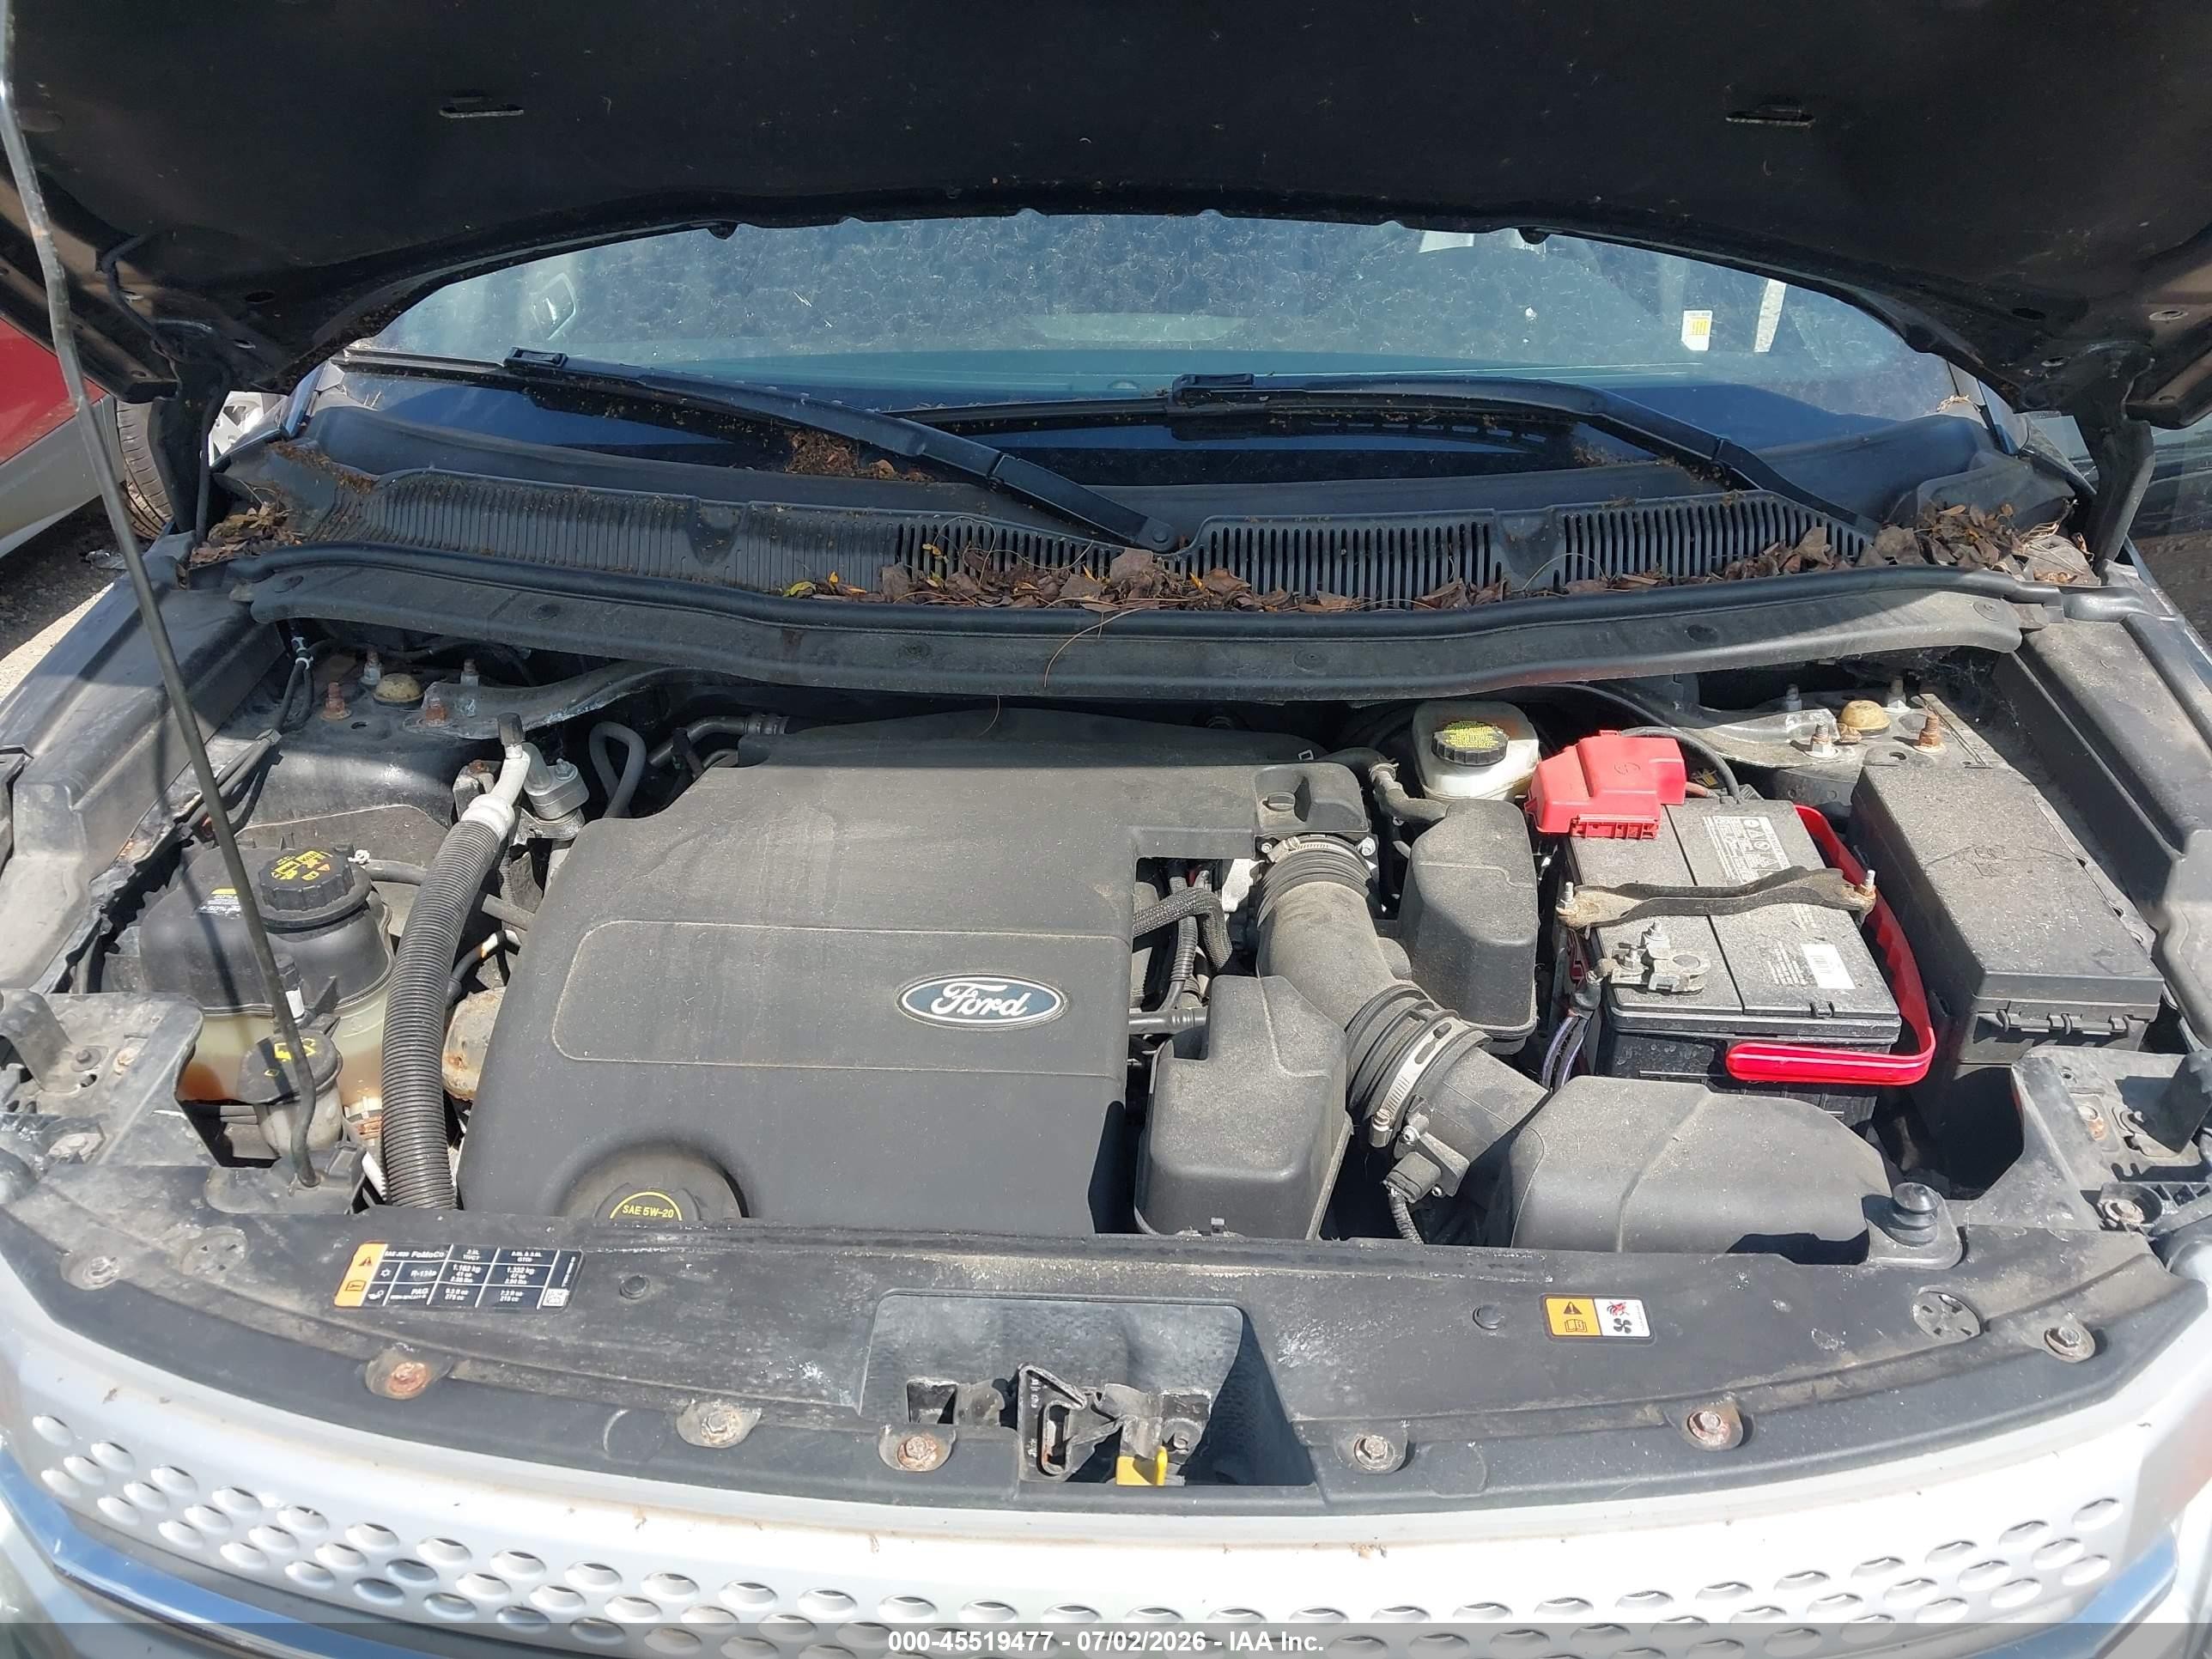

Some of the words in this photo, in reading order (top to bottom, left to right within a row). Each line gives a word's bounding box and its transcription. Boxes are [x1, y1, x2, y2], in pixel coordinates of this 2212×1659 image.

[931, 982, 1032, 1016] Ford
[623, 1204, 642, 1215] SAE
[643, 1206, 674, 1218] 5W-20
[471, 1265, 481, 1273] kg
[526, 1267, 535, 1275] kg
